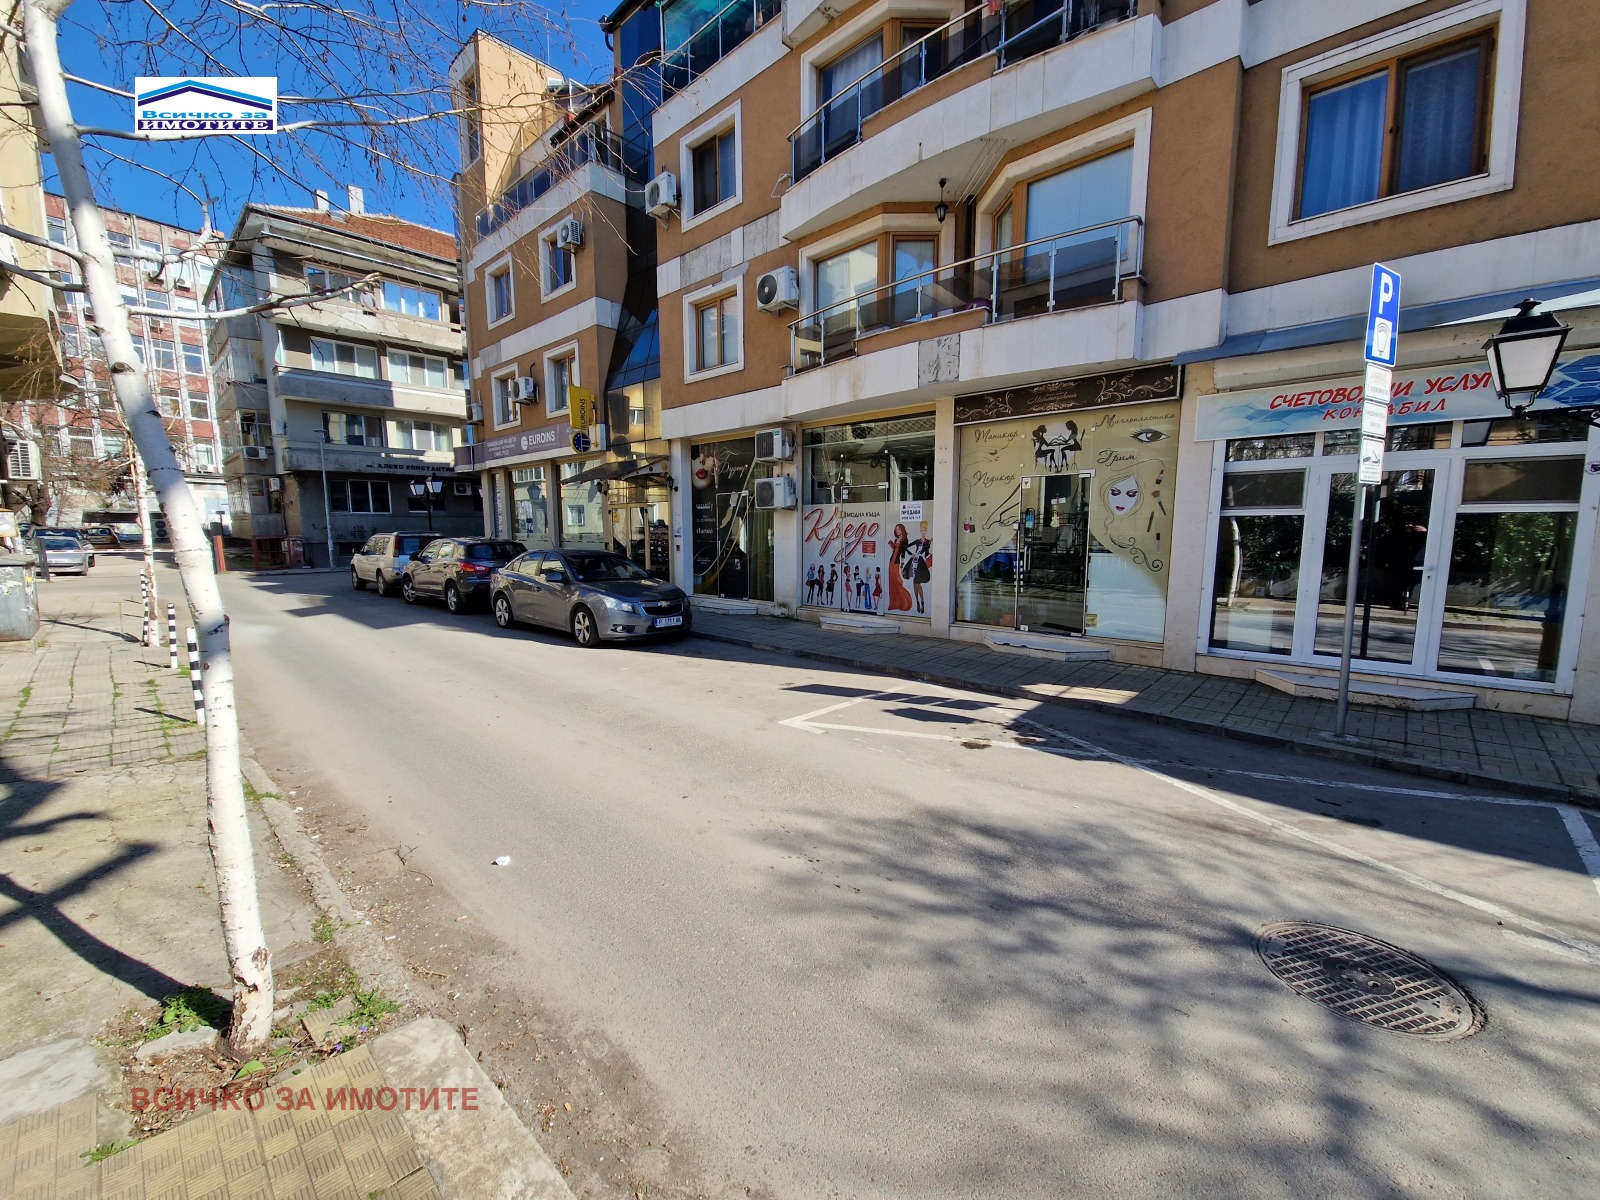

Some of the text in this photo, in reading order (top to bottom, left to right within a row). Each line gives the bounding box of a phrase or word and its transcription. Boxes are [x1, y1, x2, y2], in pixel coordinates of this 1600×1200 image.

[1378, 271, 1394, 315] P
[1269, 380, 1414, 409] СЧЕТОВОИ
[1424, 371, 1492, 395] УСЛУГ
[1322, 398, 1447, 420] КОНАБИЛ
[1096, 412, 1176, 428] Миглопластика
[528, 431, 556, 446] EUROINS
[974, 428, 1019, 443] Маникюр
[1097, 448, 1138, 467] Грим
[406, 464, 455, 472] КОНСТАНТИН
[972, 470, 1016, 488] Педикюр
[804, 507, 880, 563] Кредо
